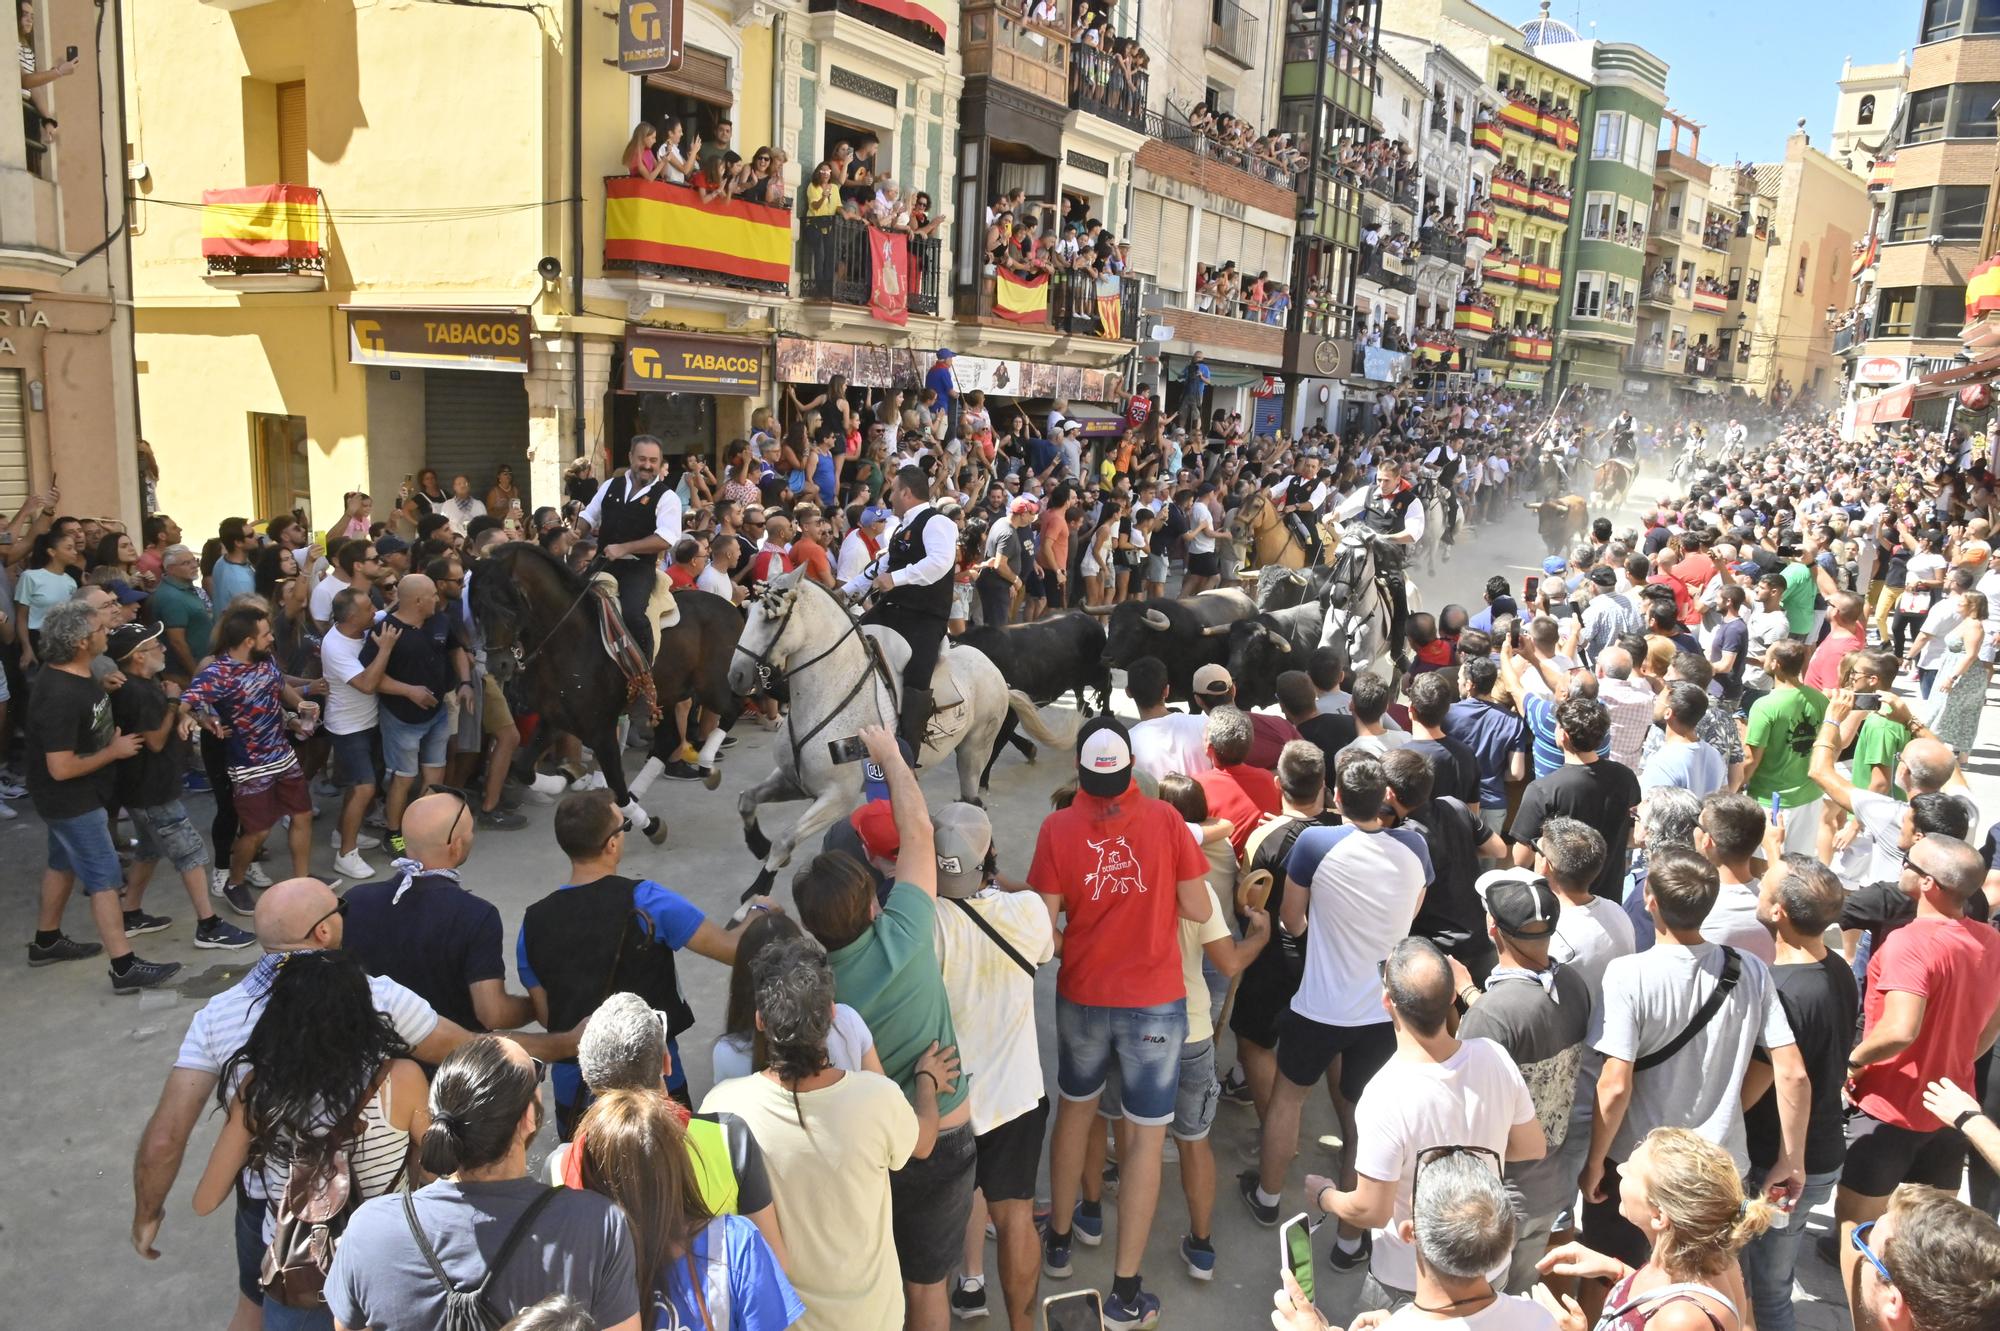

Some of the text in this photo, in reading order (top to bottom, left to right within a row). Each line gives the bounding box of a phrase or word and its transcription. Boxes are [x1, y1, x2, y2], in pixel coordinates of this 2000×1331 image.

[624, 47, 666, 62] TABACOS
[424, 322, 521, 346] TABACOS
[682, 353, 758, 373] TABACOS
[1131, 407, 1147, 422] 23
[1143, 1034, 1166, 1044] FILA
